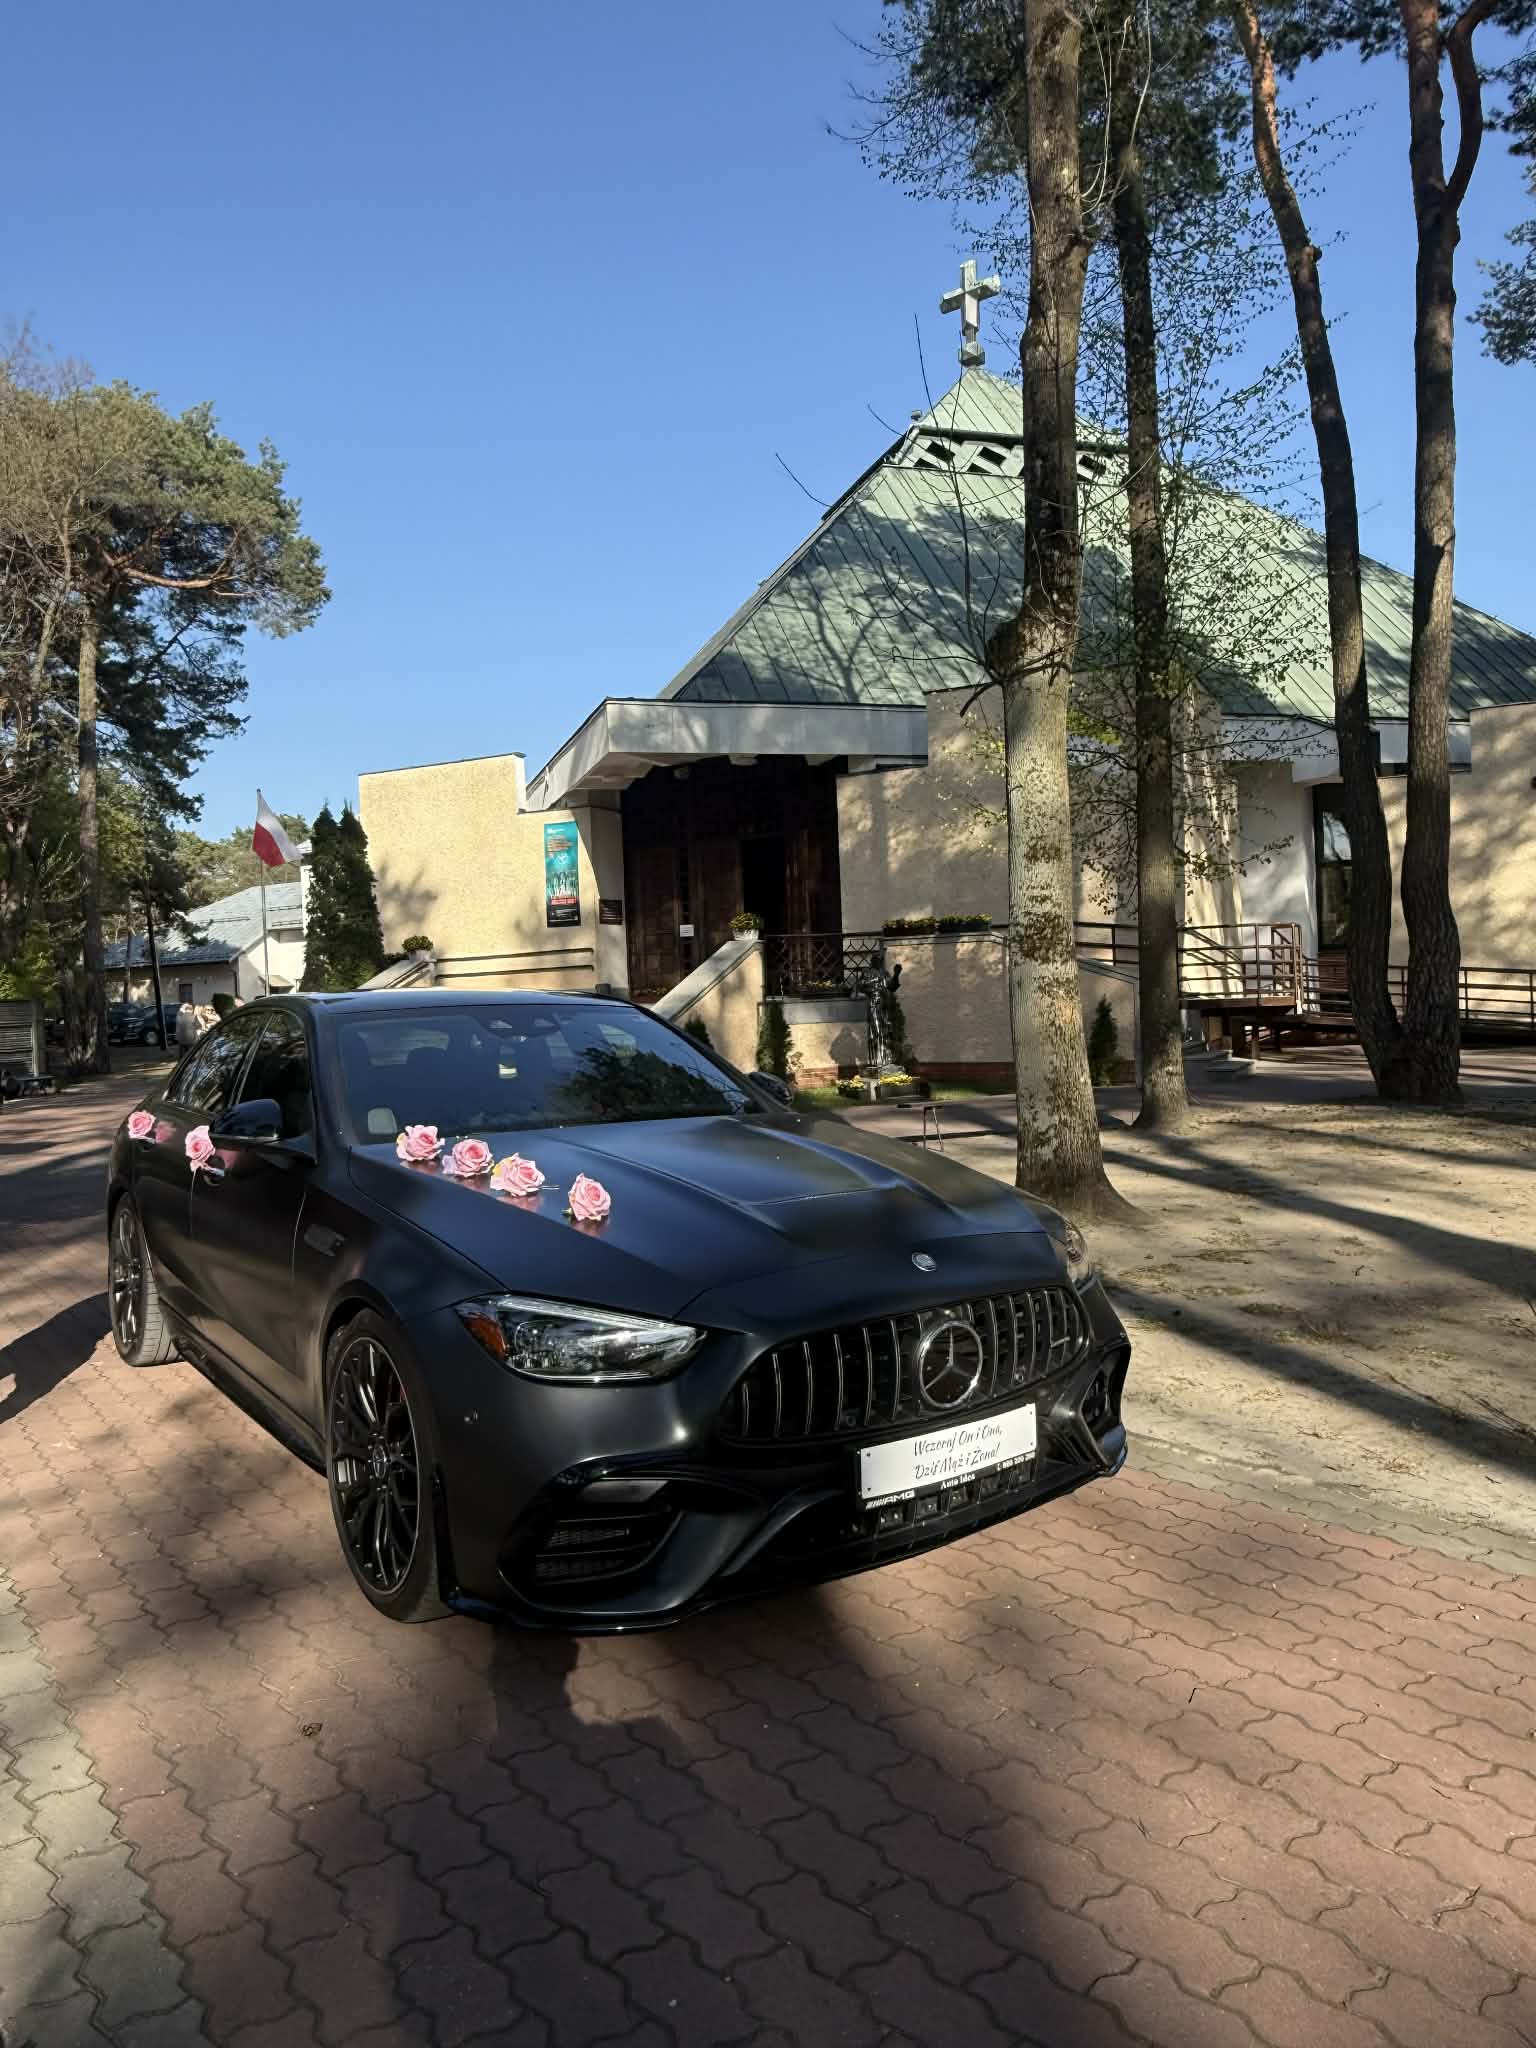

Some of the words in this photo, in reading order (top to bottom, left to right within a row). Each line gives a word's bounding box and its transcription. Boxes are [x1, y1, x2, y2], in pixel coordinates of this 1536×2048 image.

[914, 1432, 957, 1456] Wczoraj
[959, 1430, 974, 1445] On
[976, 1427, 981, 1440] i
[940, 1452, 963, 1473] Mąż
[971, 1441, 1000, 1466] Żona!
[940, 1478, 959, 1490] Auto
